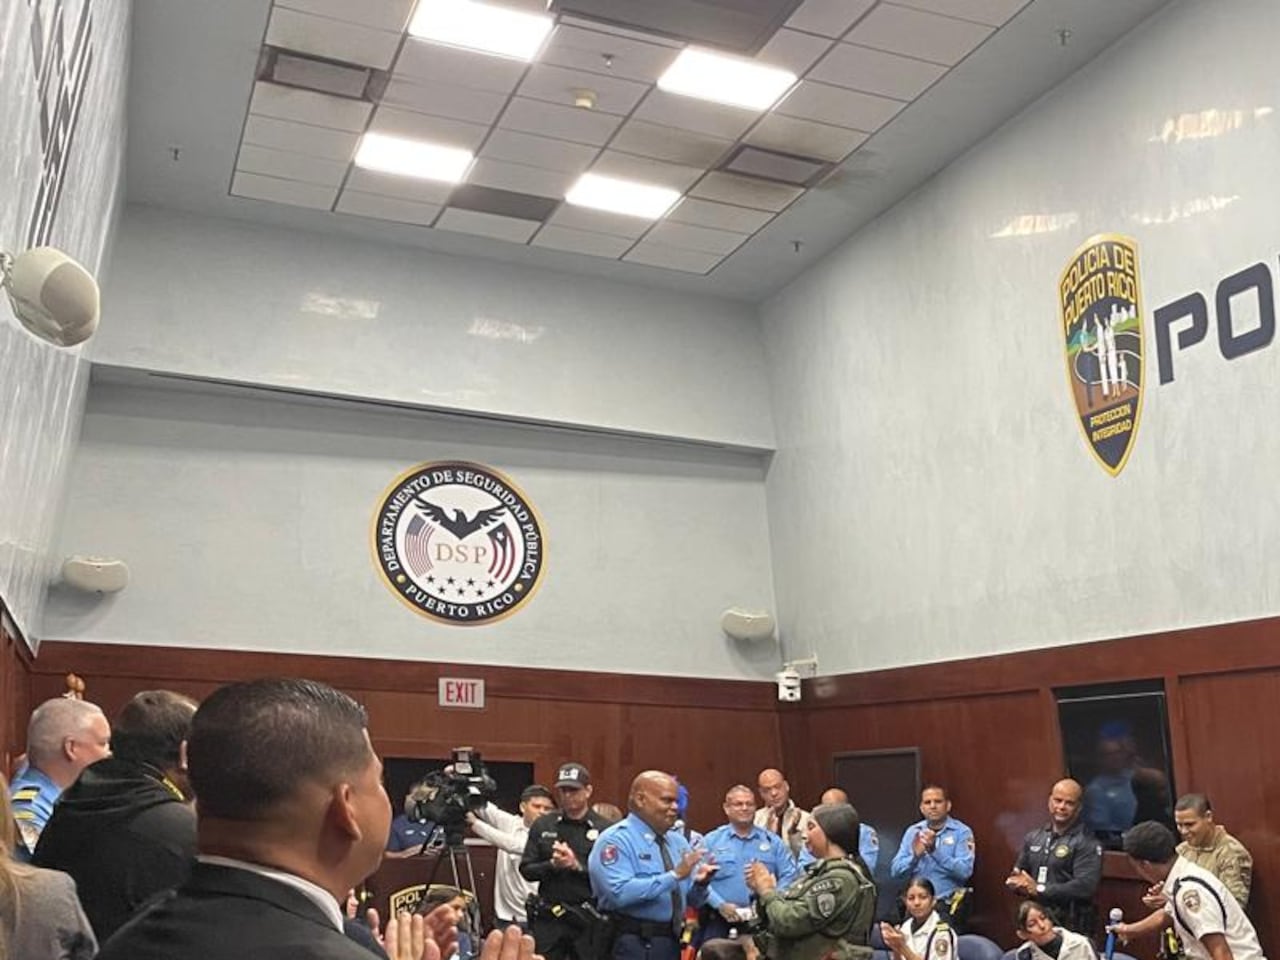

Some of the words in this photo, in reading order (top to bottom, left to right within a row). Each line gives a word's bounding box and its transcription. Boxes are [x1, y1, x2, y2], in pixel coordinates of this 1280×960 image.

[1062, 243, 1111, 308] POLICIA
[1113, 244, 1134, 276] DE
[1064, 272, 1106, 336] PUERTO
[1106, 271, 1137, 304] RICO
[382, 475, 430, 572] DEPARTAMENTO
[432, 470, 454, 484] DE
[456, 469, 529, 523] SEGURIDAD
[405, 584, 469, 617] PUERTO
[476, 592, 514, 616] RICO
[445, 681, 478, 704] EXIT
